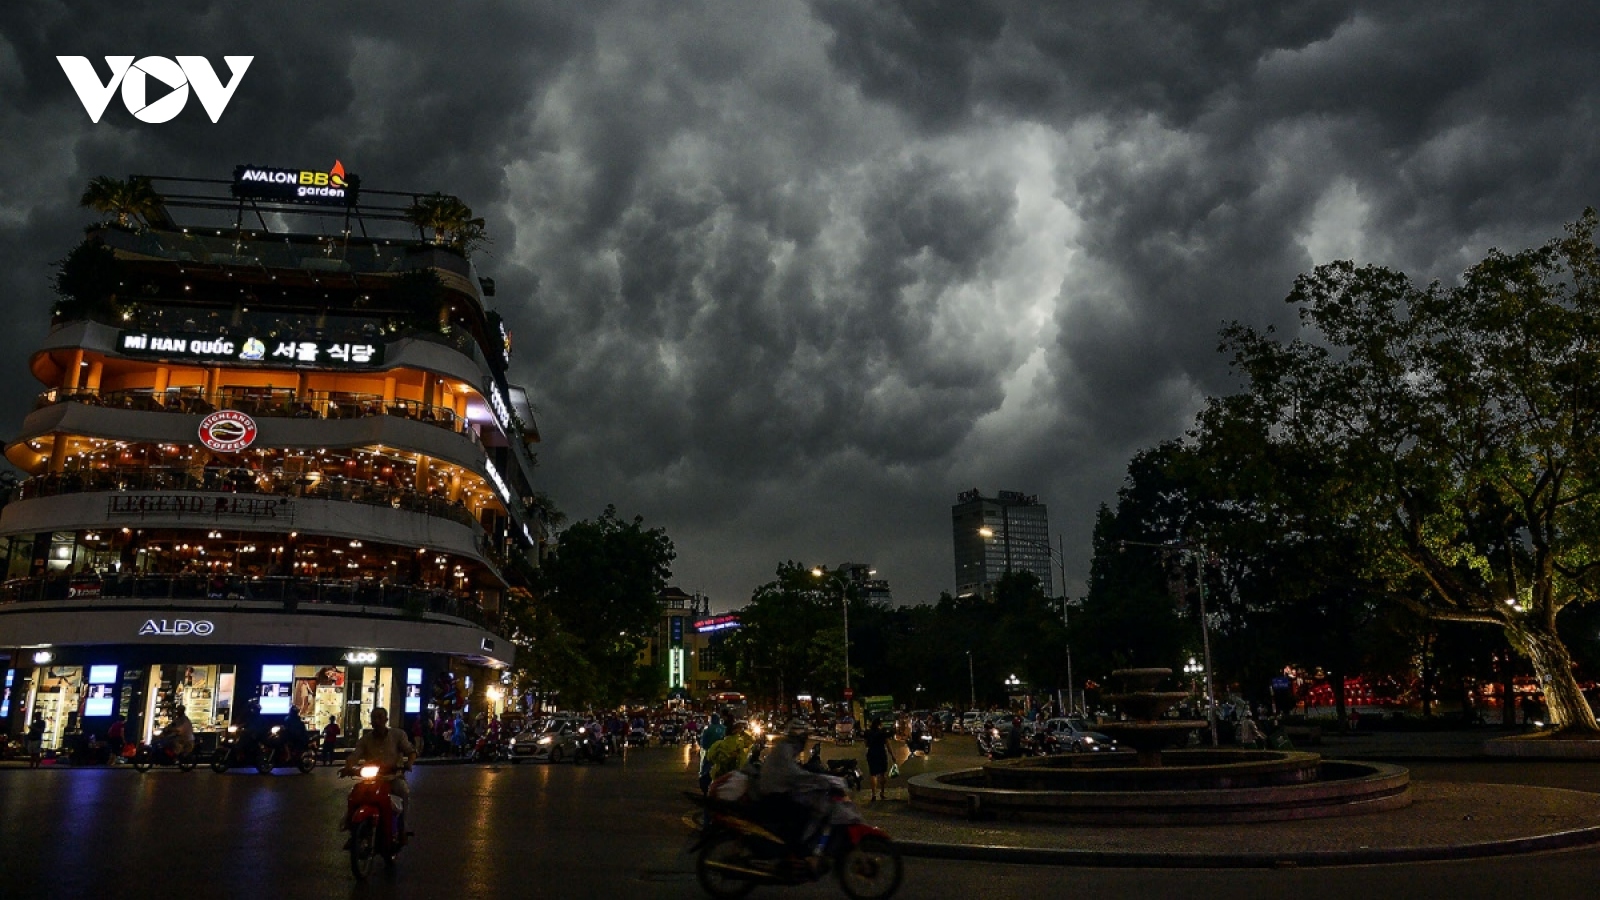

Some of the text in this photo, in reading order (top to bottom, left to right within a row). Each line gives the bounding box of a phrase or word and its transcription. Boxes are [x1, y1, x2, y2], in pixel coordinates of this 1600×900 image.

[242, 170, 297, 184] AVALON
[297, 186, 344, 197] garden
[124, 334, 147, 349] MÌ
[273, 342, 376, 362] 서울 식당
[203, 413, 254, 430] HIGHLANDS
[207, 439, 247, 449] COFFEE
[112, 496, 204, 512] LEGEND
[138, 619, 214, 636] ALDO
[340, 652, 378, 663] ALDO
